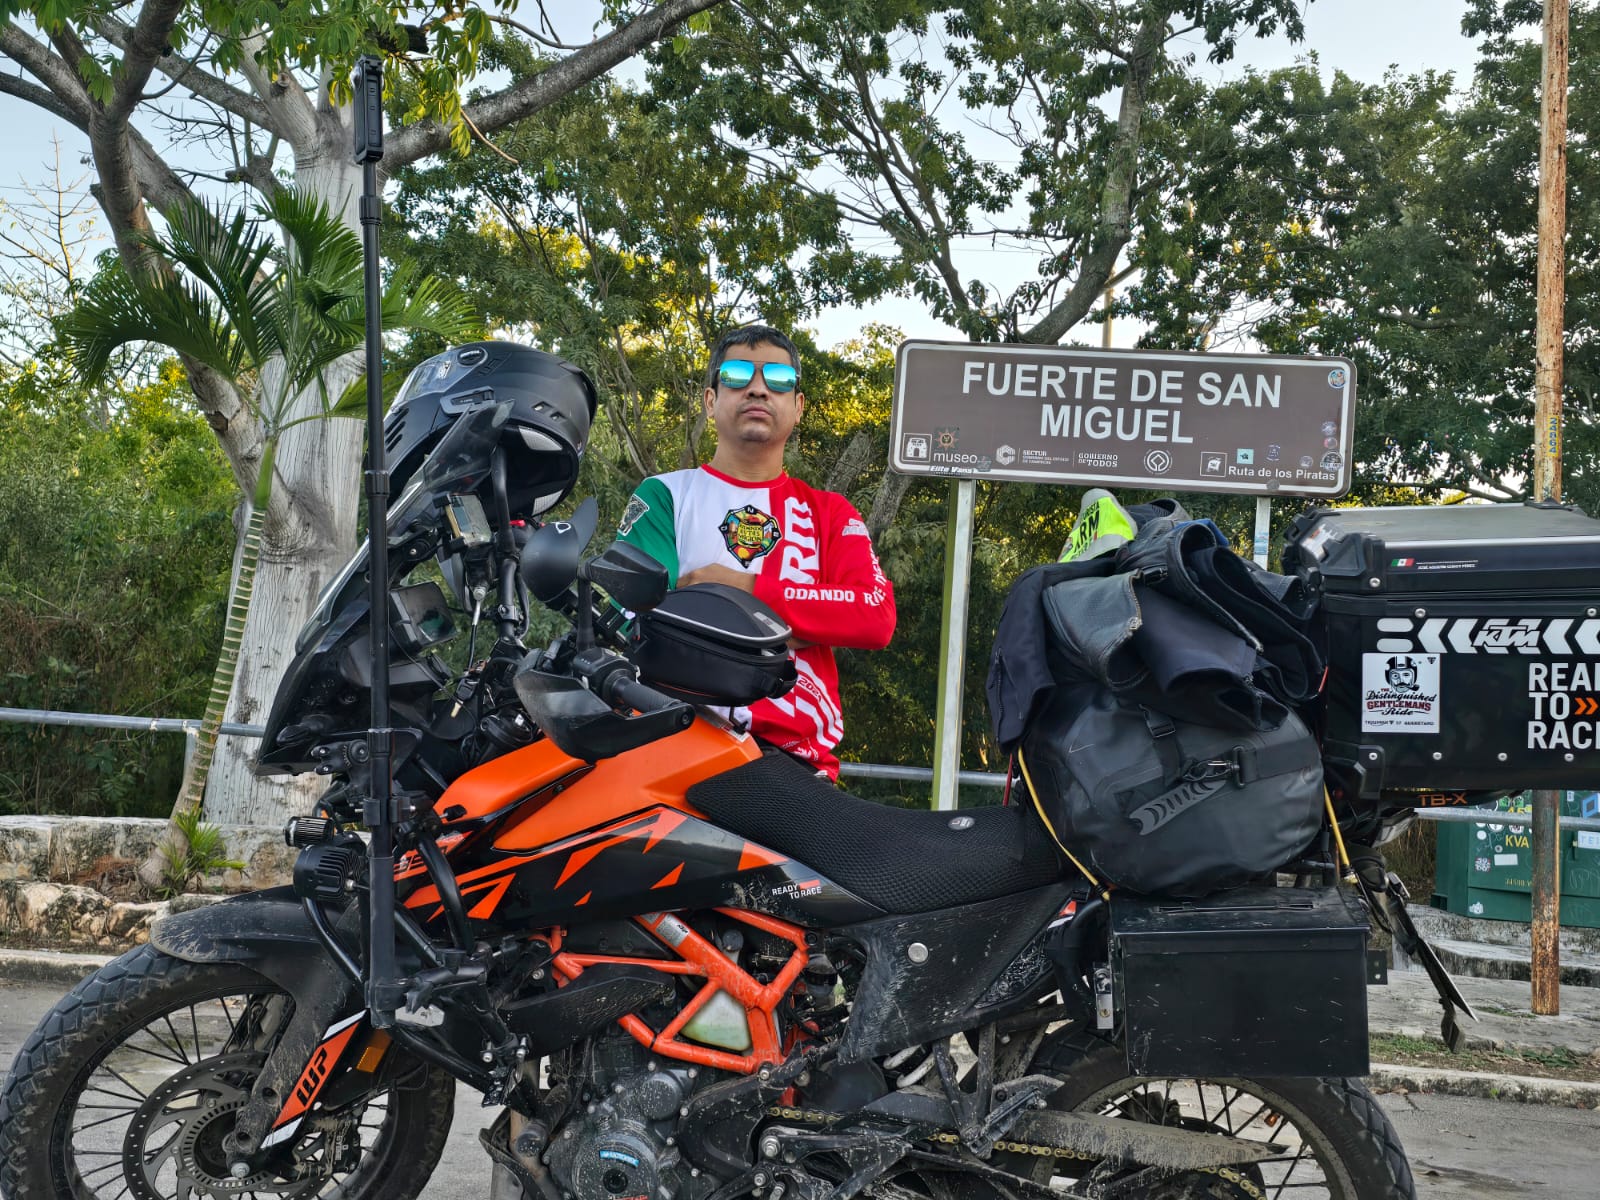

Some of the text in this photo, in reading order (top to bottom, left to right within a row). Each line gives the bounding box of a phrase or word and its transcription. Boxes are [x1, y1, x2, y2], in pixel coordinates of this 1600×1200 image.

[962, 361, 1282, 408] FUERTE DE SAN
[1040, 403, 1194, 444] MIGUEL
[933, 452, 978, 464] museo
[1078, 452, 1118, 461] GOBIERNO
[1087, 459, 1118, 468] TODOS
[1228, 466, 1336, 481] Ruta de los Piratas
[1471, 625, 1541, 647] KTM
[1528, 662, 1600, 692] REA
[1365, 690, 1437, 702] Distinguished
[1367, 700, 1432, 711] GENTLEMANS
[1528, 692, 1570, 720] TO
[1527, 721, 1600, 750] RAC
[1505, 834, 1530, 849] KVA
[772, 884, 798, 896] READY
[789, 886, 822, 900] TO RACE
